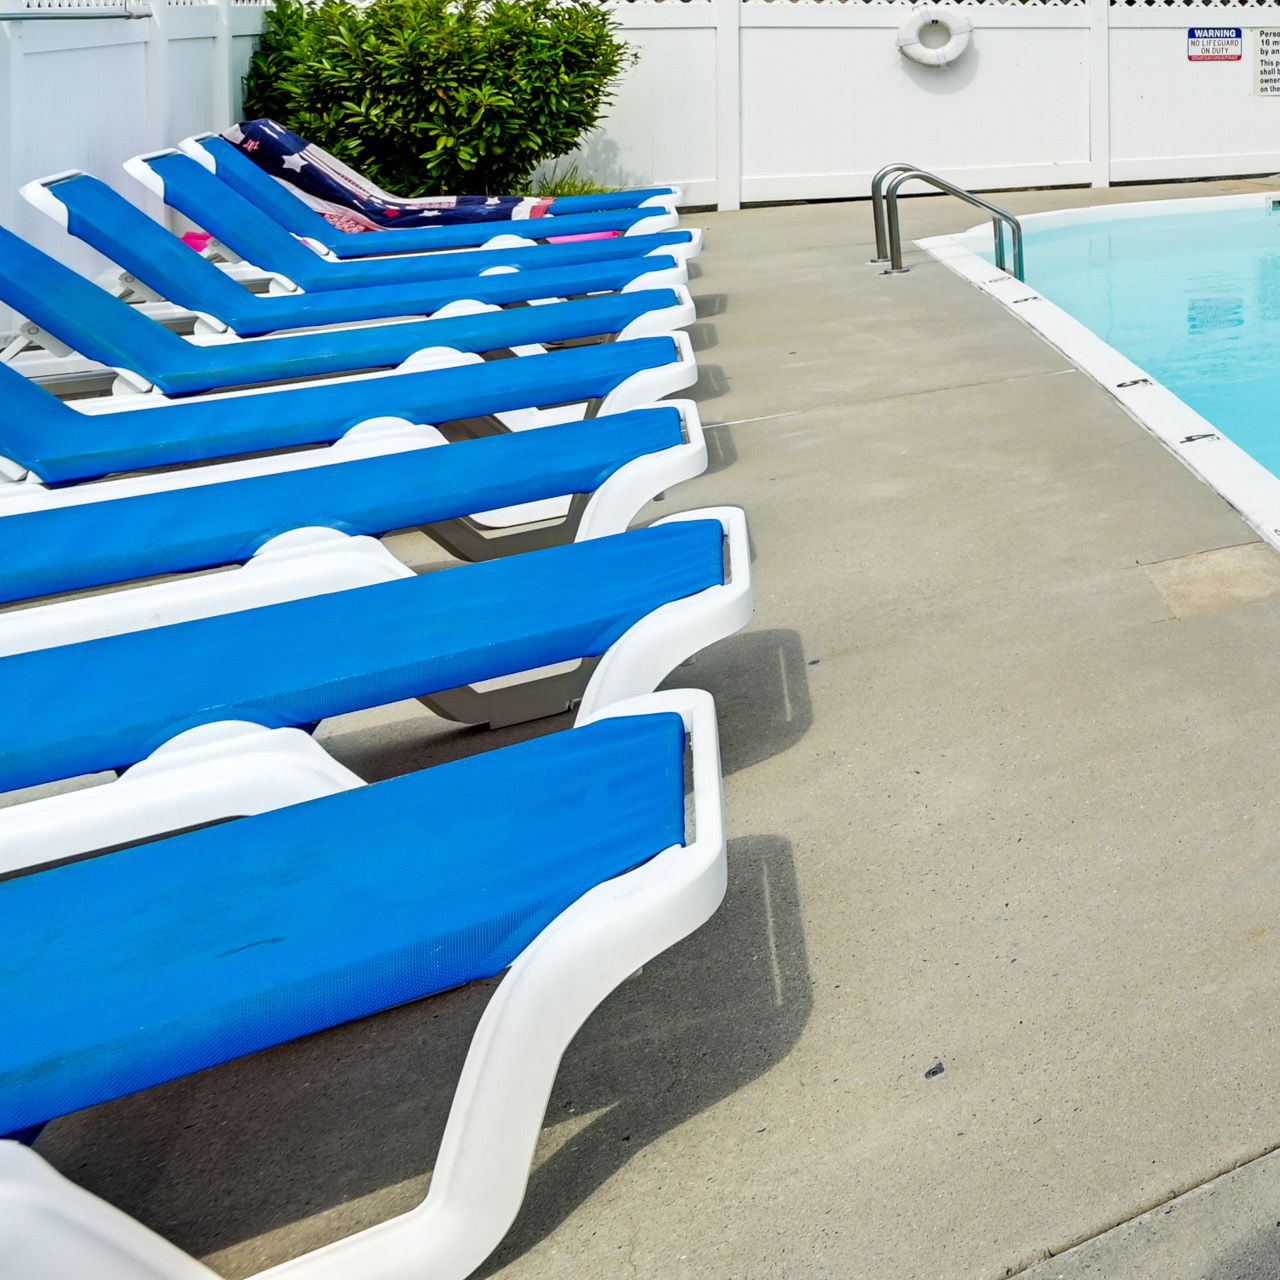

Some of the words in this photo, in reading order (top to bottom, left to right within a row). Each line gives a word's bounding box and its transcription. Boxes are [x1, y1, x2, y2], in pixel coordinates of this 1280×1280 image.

[1194, 29, 1236, 38] WARNING
[1260, 48, 1269, 56] by
[1179, 433, 1215, 444] 4
